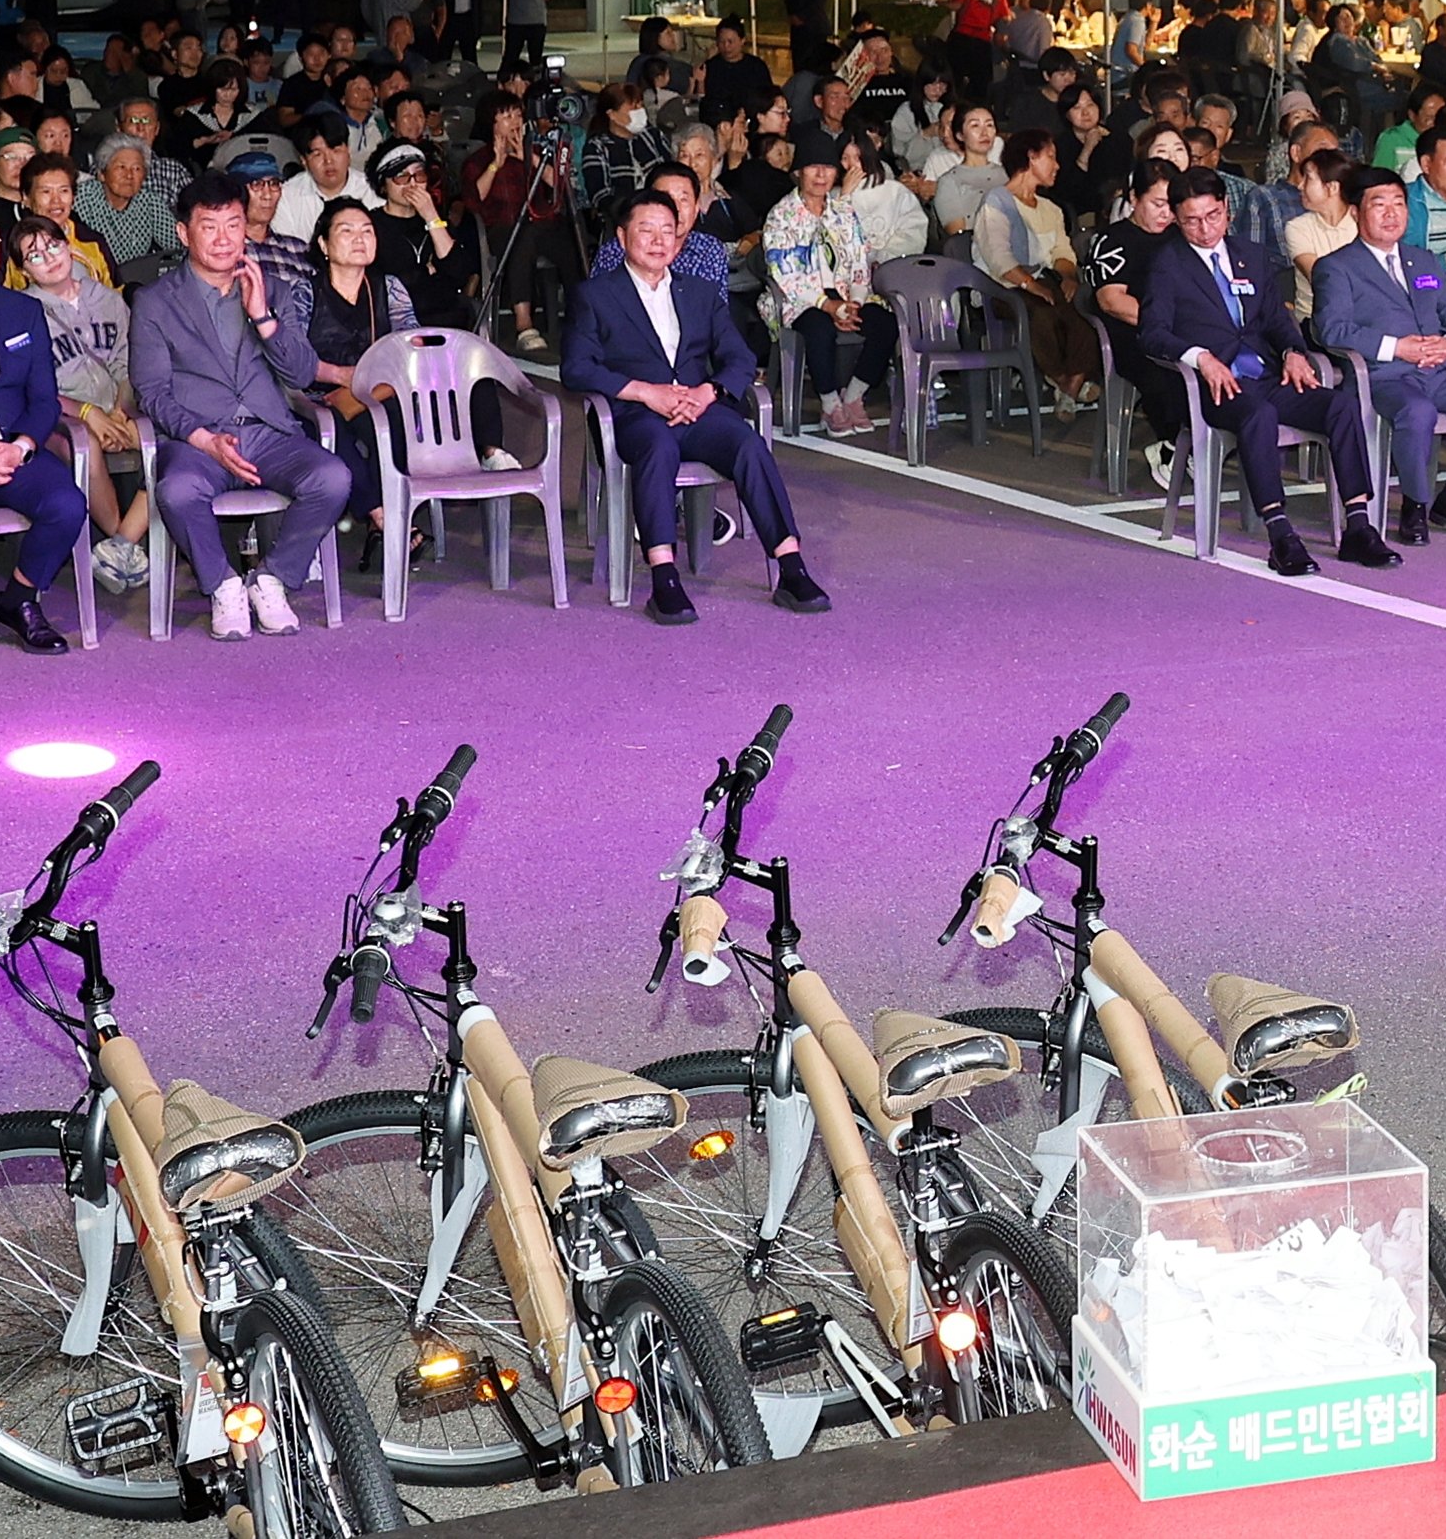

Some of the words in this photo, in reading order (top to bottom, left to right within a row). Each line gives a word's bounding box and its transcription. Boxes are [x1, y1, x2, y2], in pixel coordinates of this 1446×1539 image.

[866, 88, 906, 98] ITALIA
[1087, 1389, 1137, 1478] HWASUN
[1148, 1421, 1218, 1473] 화순
[1228, 1389, 1429, 1462] 배드민턴협회
